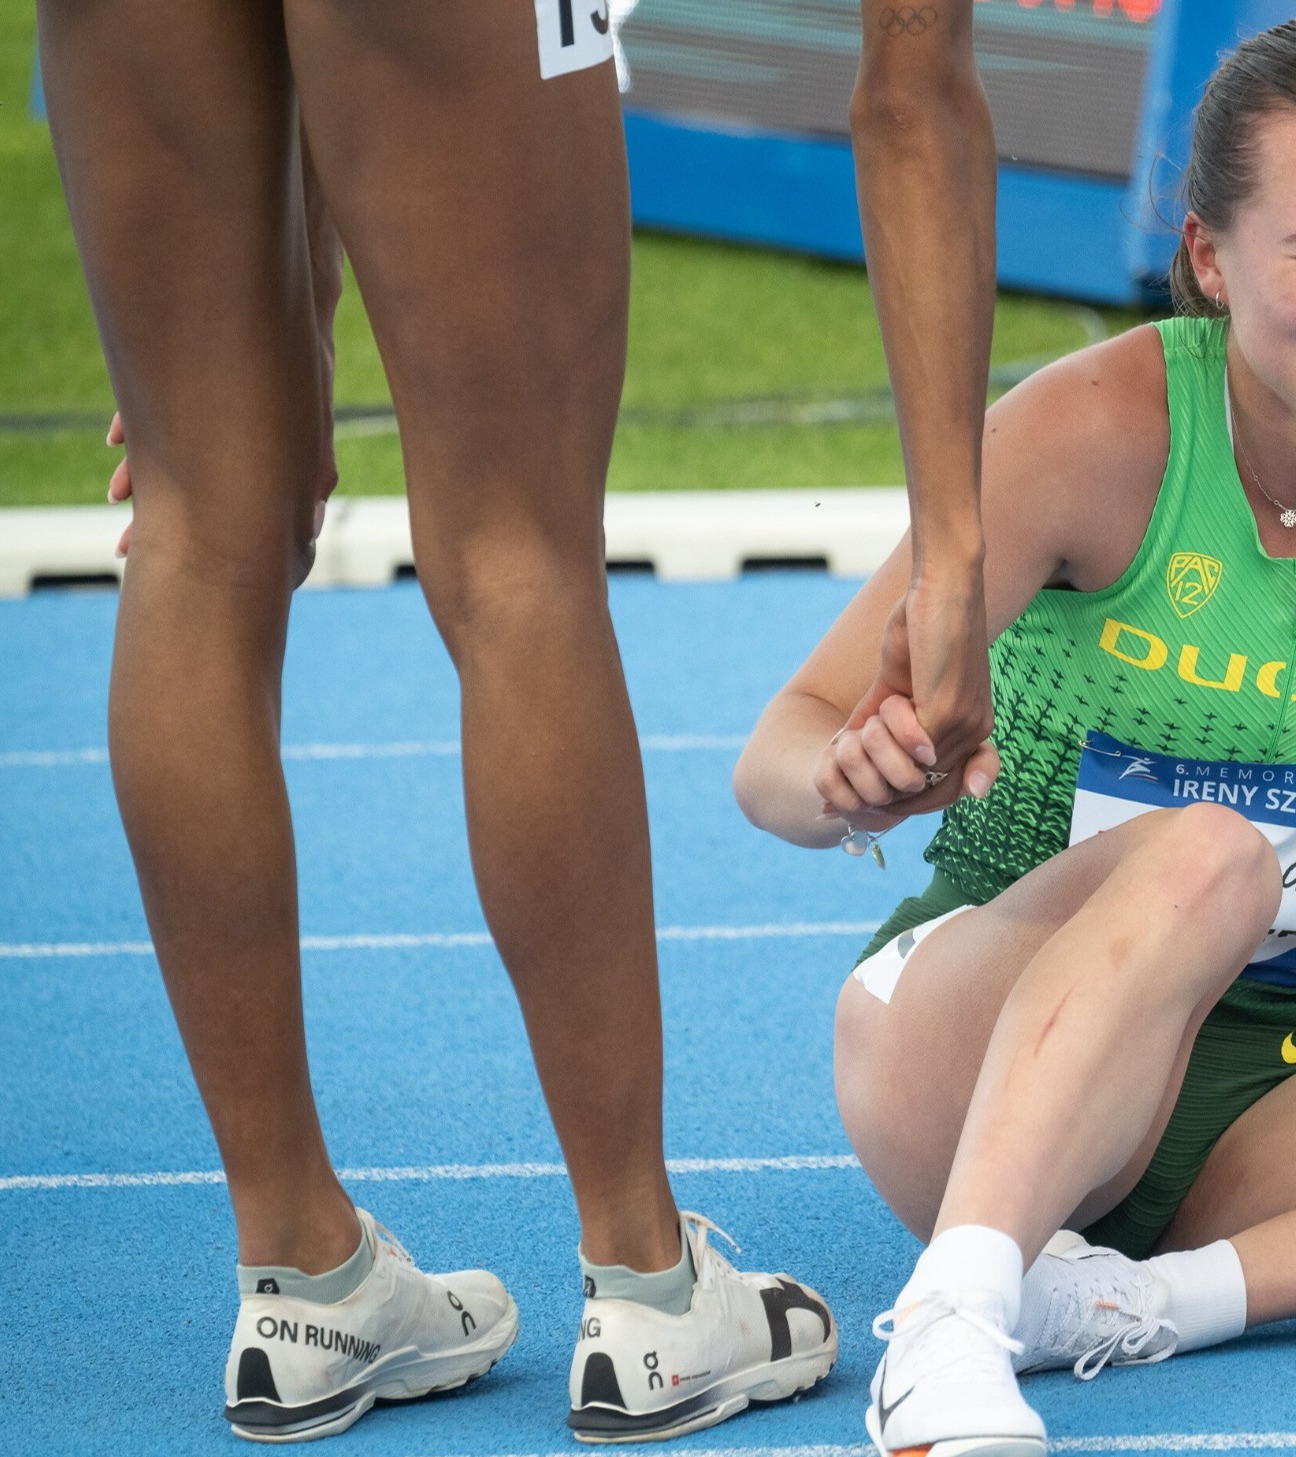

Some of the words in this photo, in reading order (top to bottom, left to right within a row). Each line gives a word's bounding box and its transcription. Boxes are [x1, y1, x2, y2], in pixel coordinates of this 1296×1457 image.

[1170, 556, 1219, 595] PAC
[1175, 580, 1203, 606] 12
[1175, 763, 1189, 776] 6.
[1172, 778, 1259, 807] IRENY
[256, 1316, 298, 1343] ON
[305, 1324, 381, 1364] RUNNING
